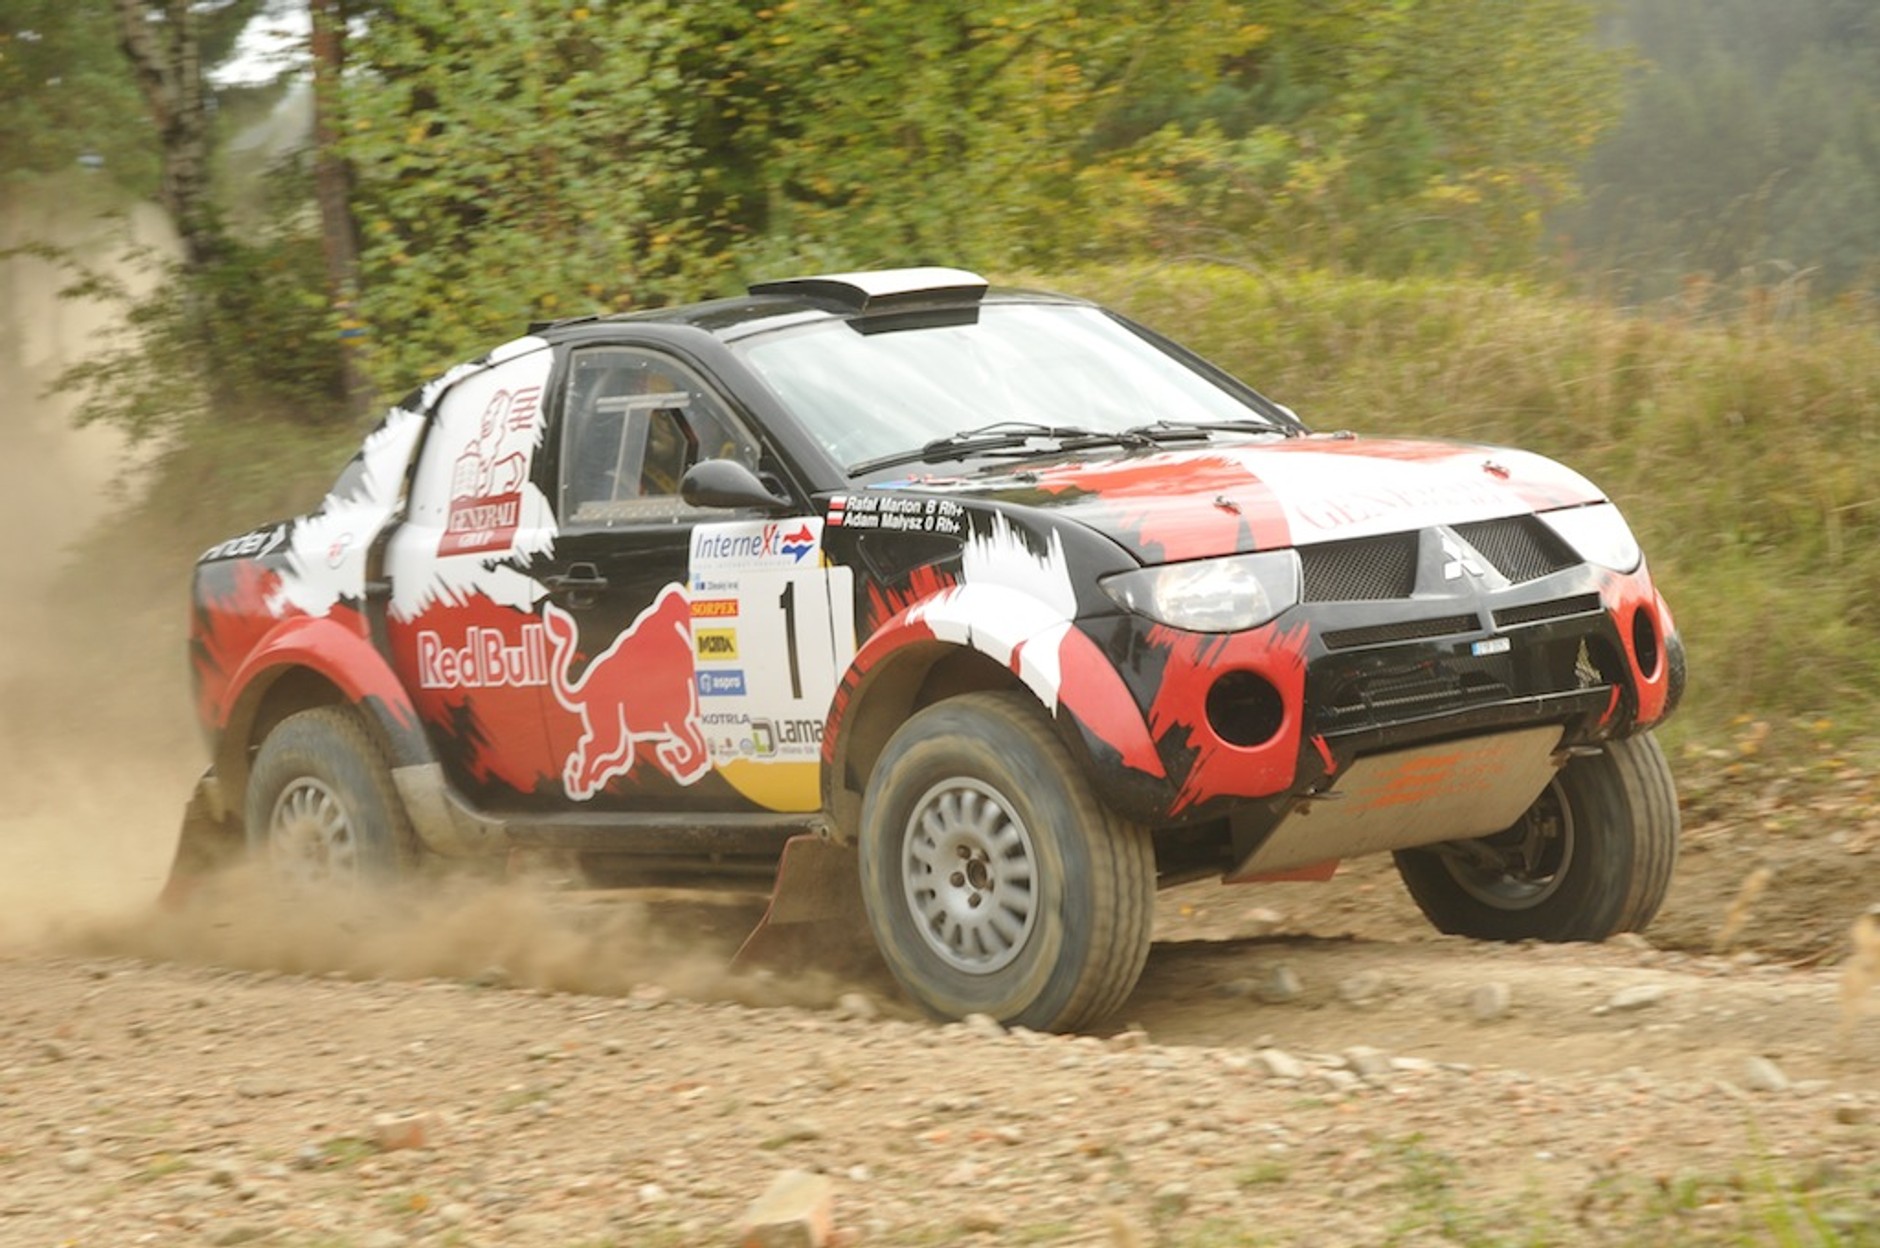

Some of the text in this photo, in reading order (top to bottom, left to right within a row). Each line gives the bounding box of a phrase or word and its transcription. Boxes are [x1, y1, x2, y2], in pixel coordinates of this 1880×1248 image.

[879, 498, 921, 514] Marton
[925, 500, 937, 514] B
[938, 501, 965, 517] Rh+
[843, 511, 880, 528] Adam
[935, 517, 961, 534] Rh+
[779, 581, 803, 700] 1
